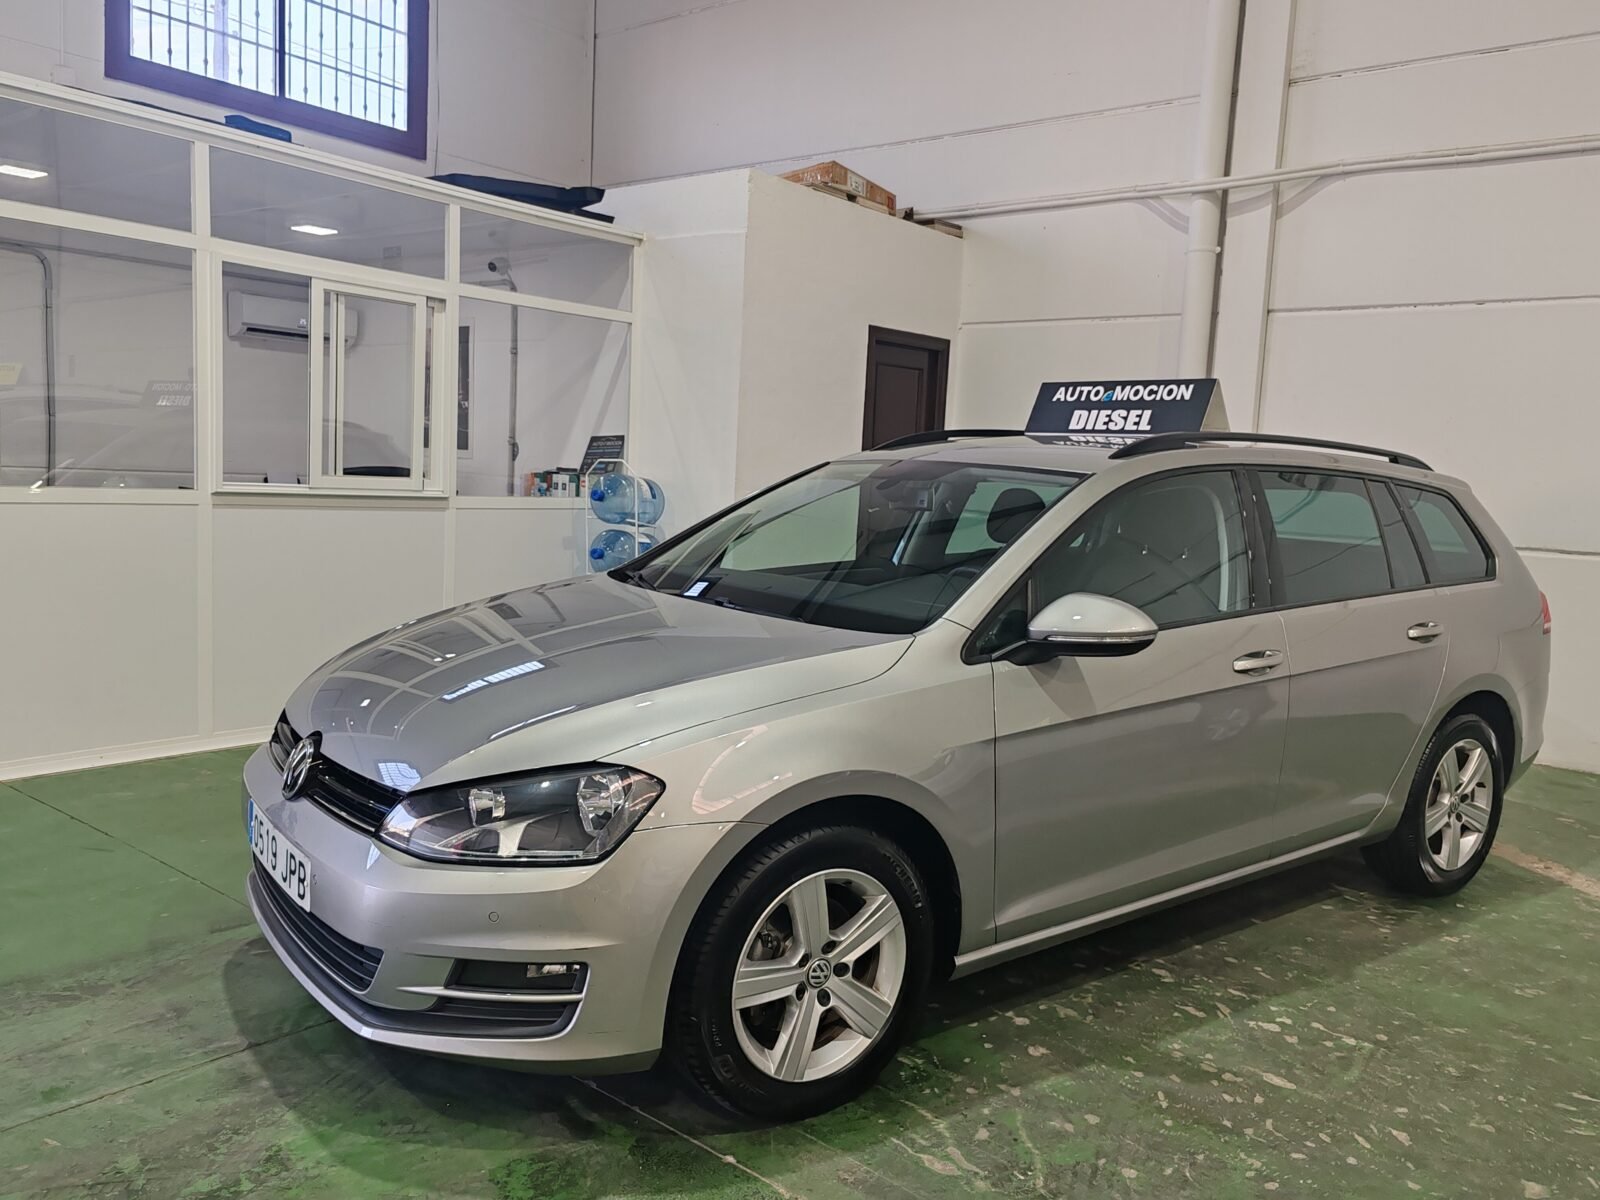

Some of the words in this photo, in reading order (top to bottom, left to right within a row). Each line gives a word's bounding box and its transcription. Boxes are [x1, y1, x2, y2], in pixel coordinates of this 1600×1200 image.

[1068, 409, 1152, 431] DIESEL
[254, 814, 278, 872] 0519
[281, 848, 307, 900] JPB
